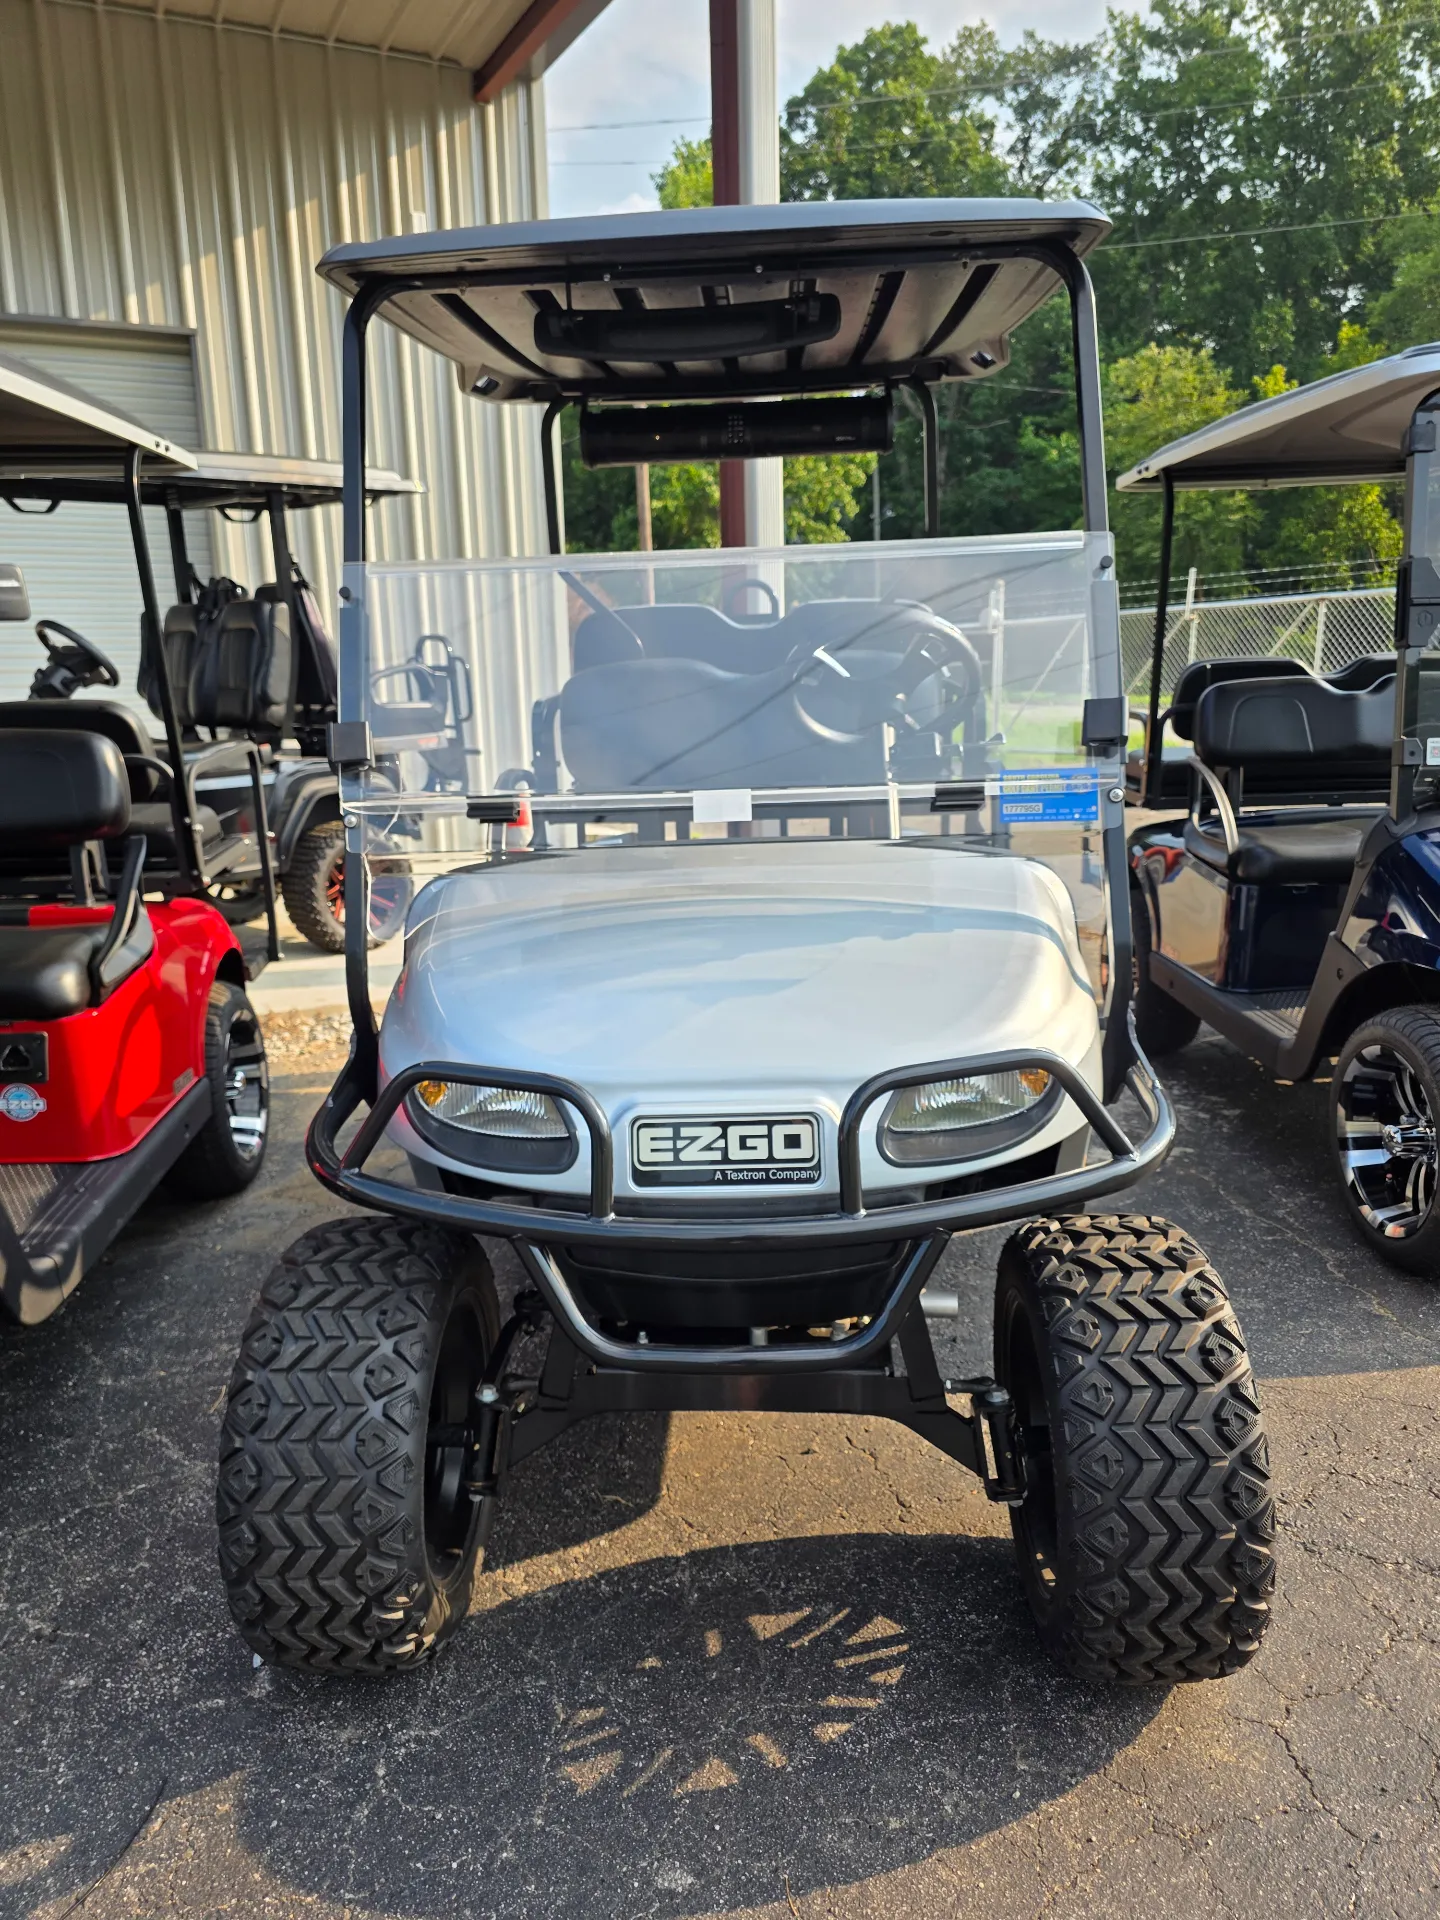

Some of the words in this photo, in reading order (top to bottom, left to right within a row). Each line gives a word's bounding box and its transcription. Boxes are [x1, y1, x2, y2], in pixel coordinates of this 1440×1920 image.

[1004, 804, 1041, 813] 177795G
[714, 1171, 723, 1180] A
[725, 1170, 766, 1180] Textron
[769, 1169, 820, 1181] Company
